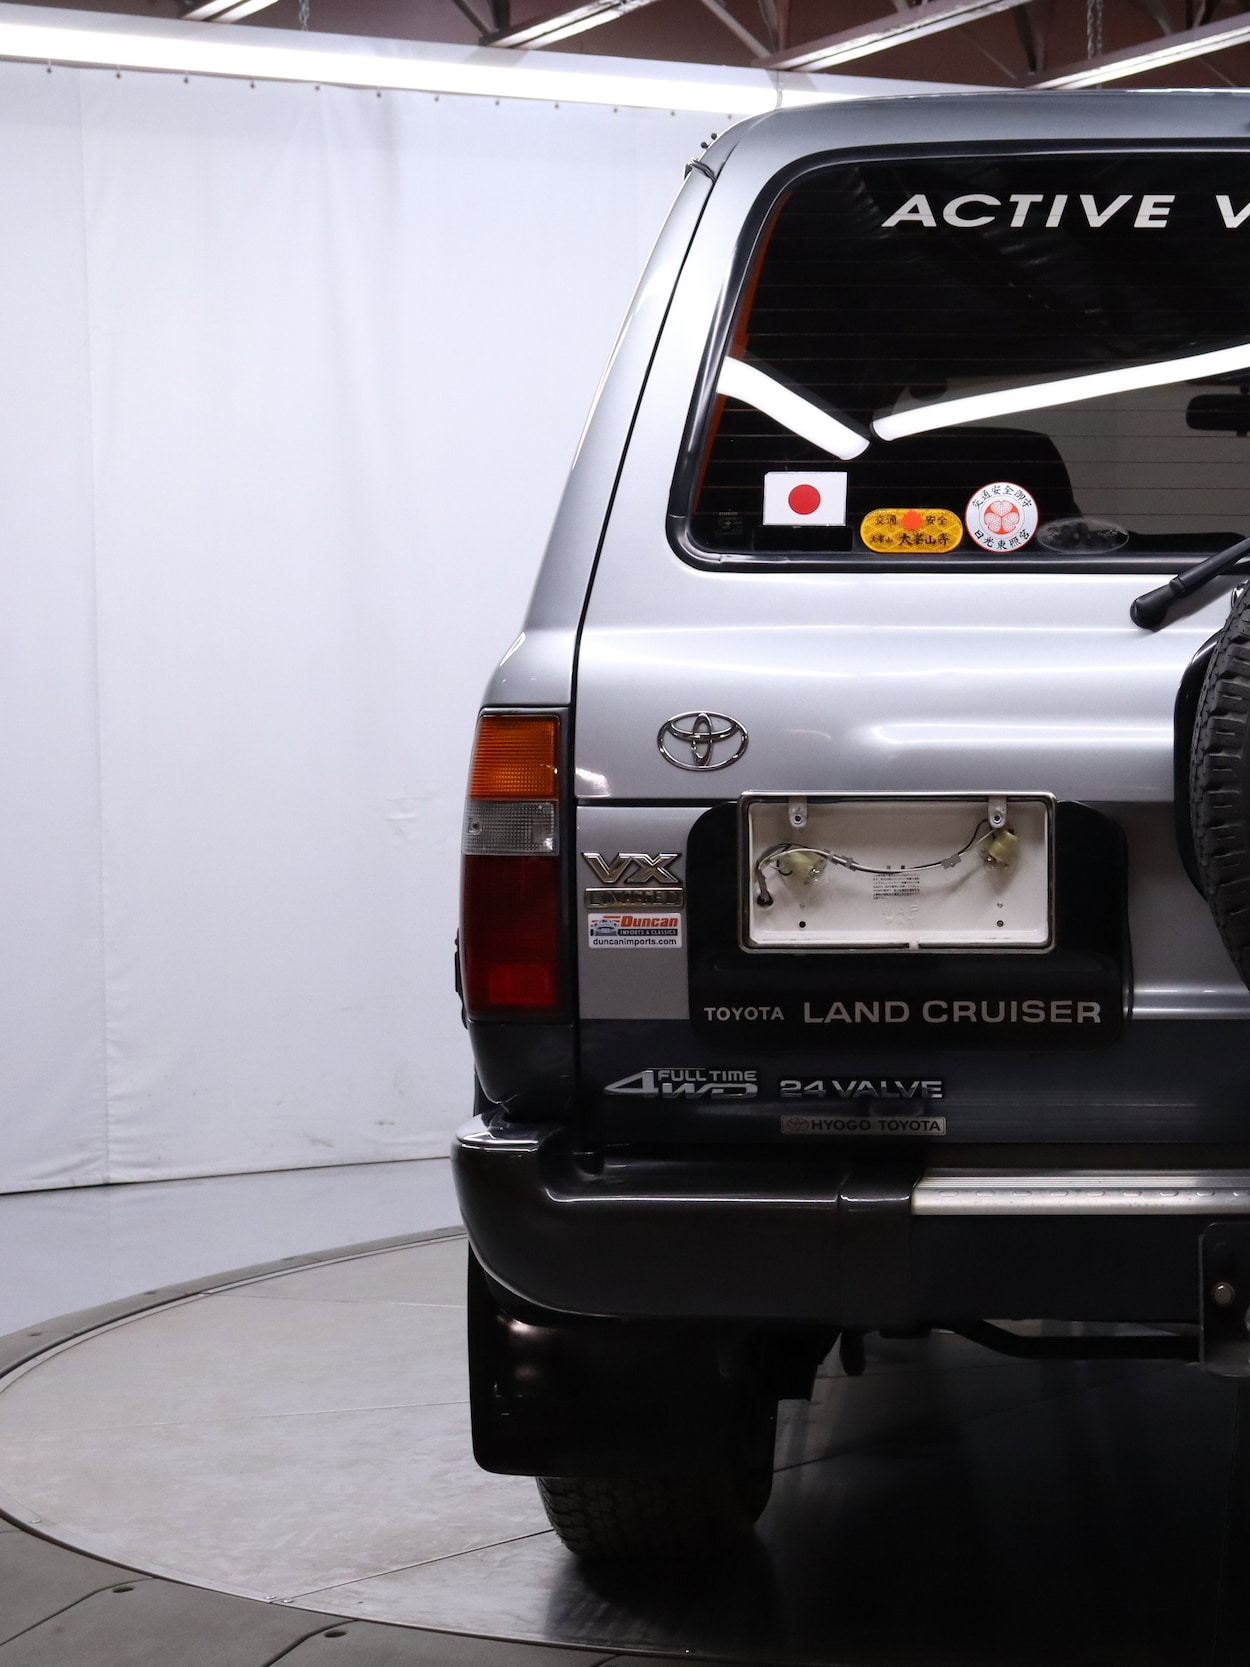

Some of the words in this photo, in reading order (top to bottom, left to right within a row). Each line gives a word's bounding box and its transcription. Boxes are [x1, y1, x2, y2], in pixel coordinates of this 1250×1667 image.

[882, 194, 1175, 229] ACTIVE
[581, 852, 682, 884] VX
[621, 915, 679, 928] Duncan
[593, 938, 677, 947] duncanimports.com
[704, 1006, 785, 1021] TOYOTA
[804, 1000, 910, 1024] LAND
[922, 1000, 1102, 1024] CRUISER
[604, 1070, 759, 1099] 4WD
[658, 1070, 706, 1082] FULL
[709, 1070, 758, 1082] TIME
[780, 1080, 827, 1097] 24
[831, 1080, 943, 1098] VALVE
[811, 1119, 871, 1131] HYOGO
[878, 1119, 941, 1132] TOYOTA
